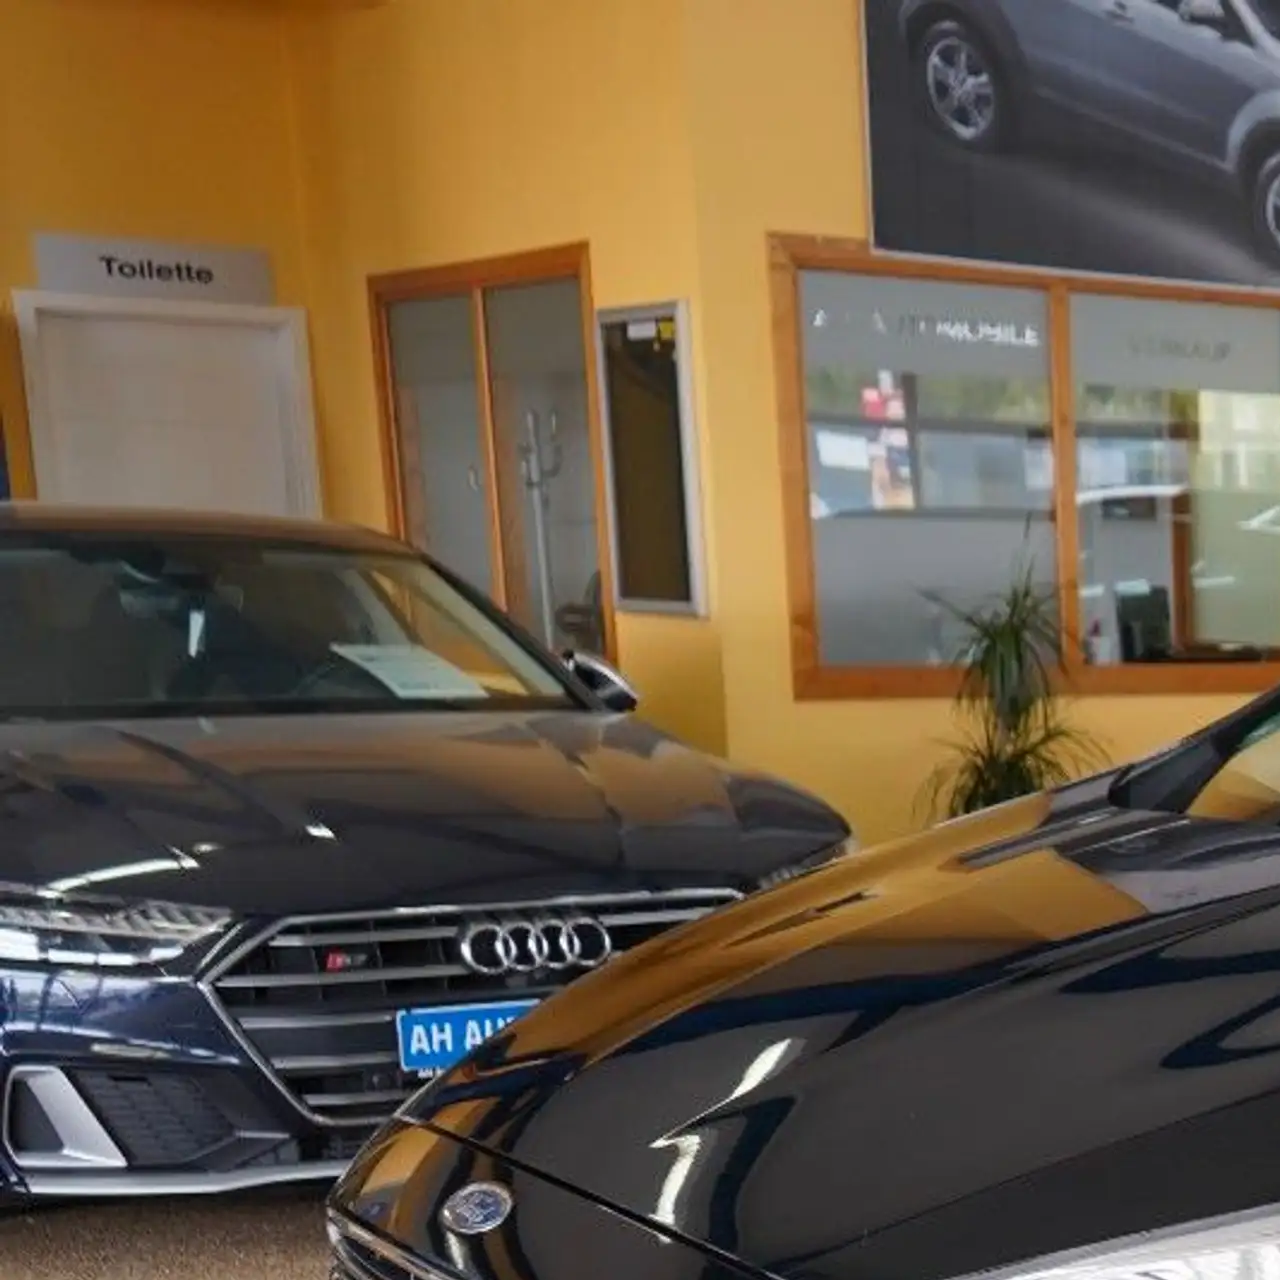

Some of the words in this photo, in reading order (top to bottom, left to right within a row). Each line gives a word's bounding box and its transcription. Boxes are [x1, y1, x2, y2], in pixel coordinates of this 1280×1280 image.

[99, 255, 214, 284] Toilette
[410, 1022, 454, 1055] AH
[465, 1016, 516, 1051] AU
